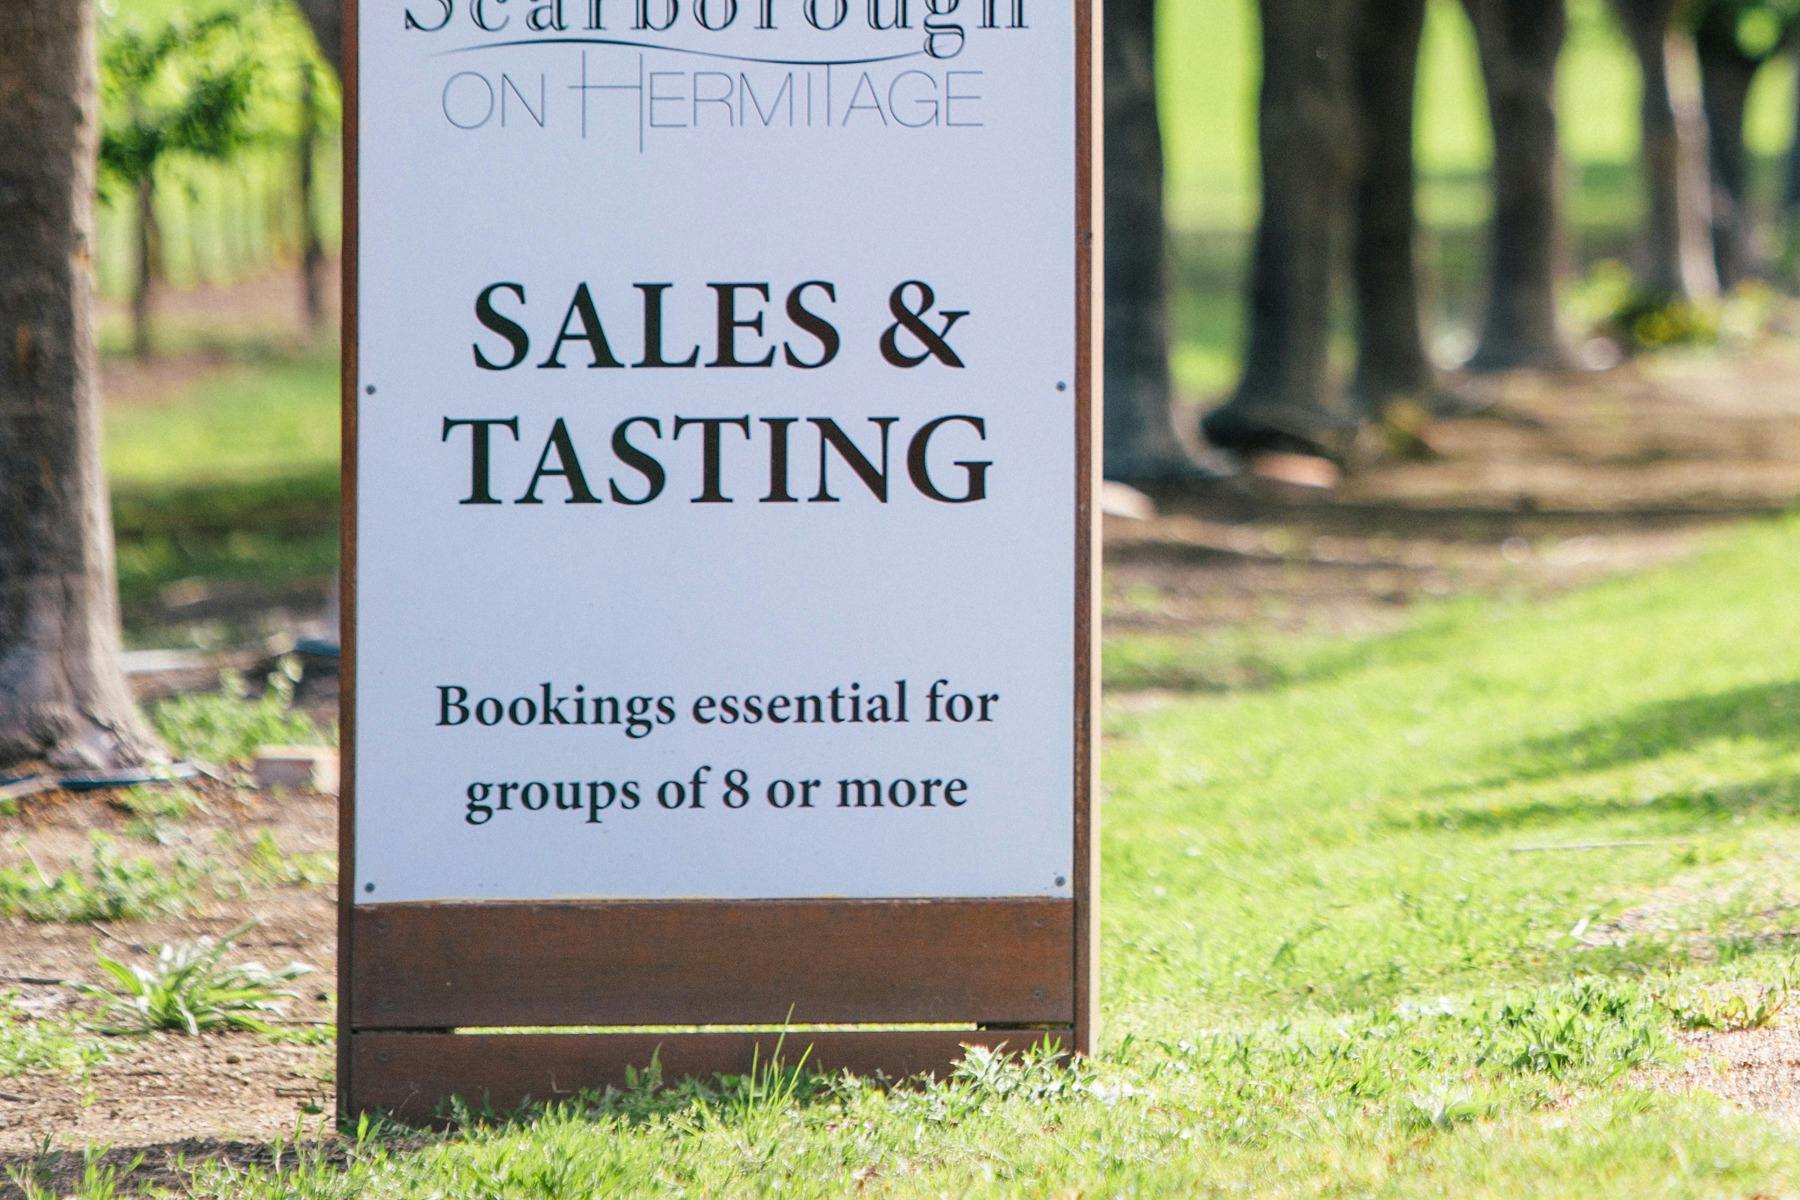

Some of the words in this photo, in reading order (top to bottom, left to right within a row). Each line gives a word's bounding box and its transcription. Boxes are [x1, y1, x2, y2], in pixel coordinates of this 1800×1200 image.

[441, 70, 547, 130] ON
[470, 279, 842, 372] SALES
[878, 279, 971, 370] &
[441, 413, 995, 506] TASTING
[434, 681, 677, 740] Bookings
[691, 679, 910, 726] essential
[925, 678, 1000, 724] for
[464, 780, 642, 826] groups
[656, 764, 713, 811] of
[721, 768, 751, 810] 8
[766, 778, 822, 809] or
[836, 778, 969, 809] more
